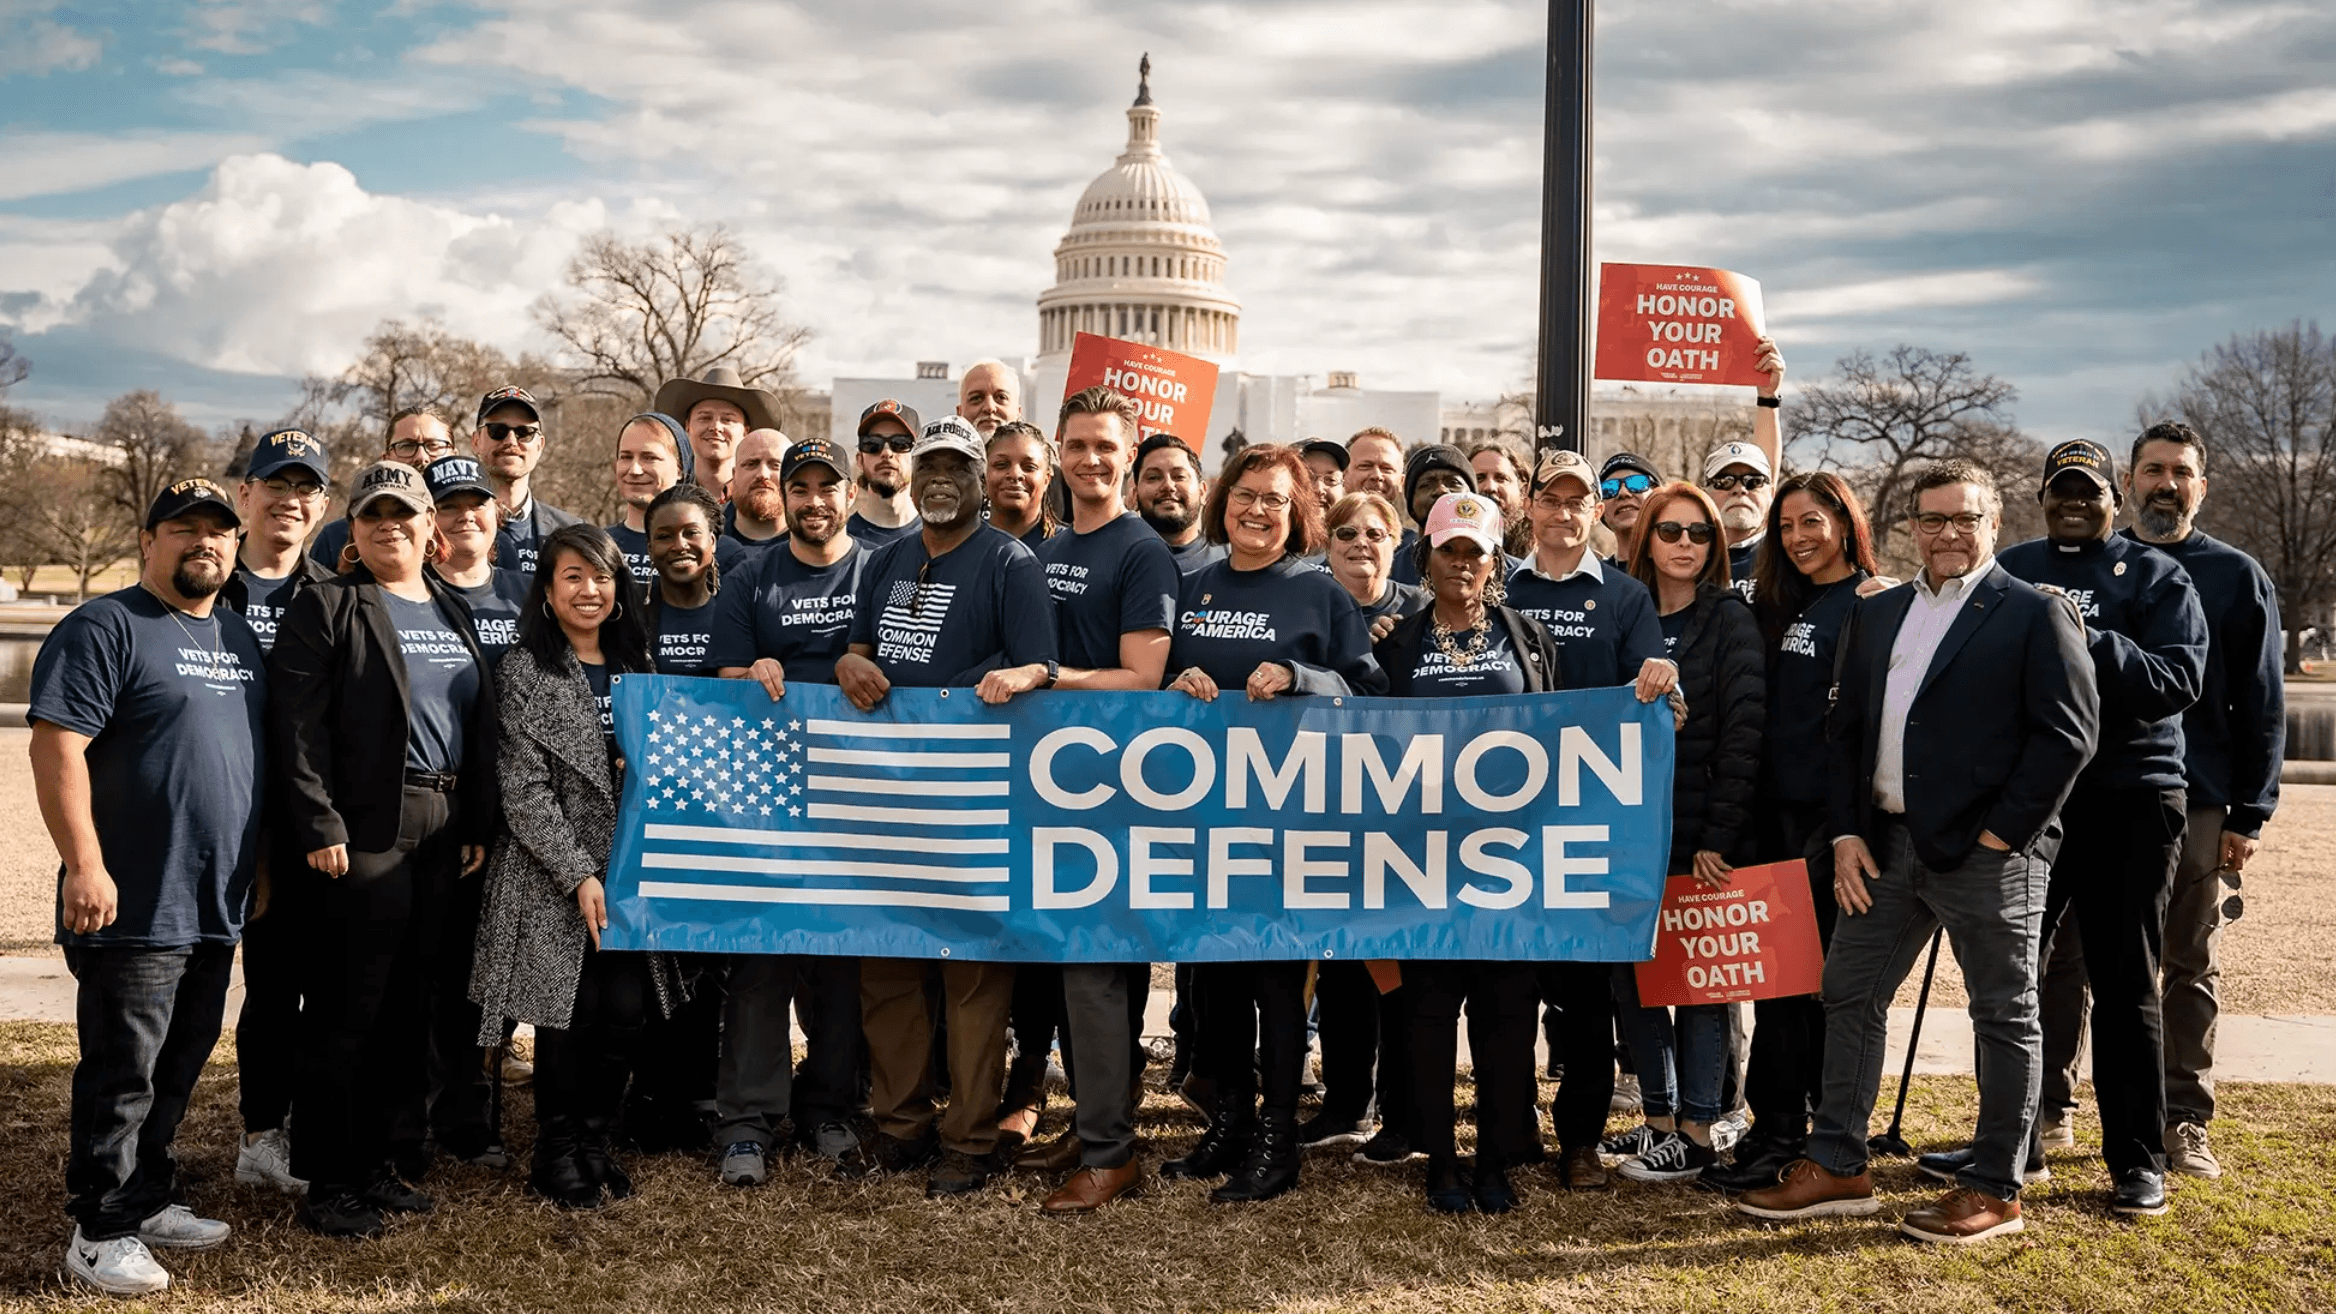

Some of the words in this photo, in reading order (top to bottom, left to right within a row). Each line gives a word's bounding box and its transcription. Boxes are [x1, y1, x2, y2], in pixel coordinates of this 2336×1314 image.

[1656, 283, 1678, 291] HAVE
[1679, 284, 1718, 293] COURAGE
[1636, 294, 1735, 319] HONOR
[1648, 321, 1722, 344] YOUR
[1124, 360, 1143, 369] HAVE
[1647, 347, 1719, 370] OATH
[1103, 367, 1188, 404] HONOR
[1129, 397, 1175, 425] OUR
[925, 424, 941, 438] AIR
[942, 422, 972, 442] FORCE
[270, 430, 321, 456] VETERAN
[2057, 455, 2099, 468] VETERAN
[361, 467, 413, 490] ARMY
[432, 459, 479, 483] NAVY
[441, 475, 476, 485] VETERAN
[170, 478, 228, 502] VETERAN
[1045, 563, 1069, 575] VETS
[1069, 565, 1089, 578] FOR
[1048, 578, 1088, 595] OCRACY
[246, 604, 271, 618] ETS
[791, 597, 829, 609] VETS
[474, 618, 516, 632] RAGE
[781, 609, 856, 626] DEMOCRA
[1554, 610, 1585, 622] FOR
[398, 630, 436, 640] VETS
[478, 631, 521, 644] ERIC
[692, 634, 710, 644] FO
[878, 627, 937, 648] COMMON
[1192, 624, 1276, 642] AMERICA
[178, 648, 211, 663] VETS
[211, 652, 240, 664] FOR
[400, 643, 472, 656] DEMOCRA
[877, 643, 933, 663] EFENSE
[1423, 653, 1452, 664] VET
[1474, 650, 1498, 661] OR
[175, 663, 255, 681] DEMOCRACY
[1029, 722, 1643, 814] COMMON
[1032, 825, 1610, 909] DEFENSE
[1678, 894, 1700, 903] HAVE
[1701, 889, 1745, 902] COURAGE
[1662, 900, 1770, 931] HONOR
[1679, 931, 1761, 959] YOUR
[1687, 961, 1765, 988] OATH
